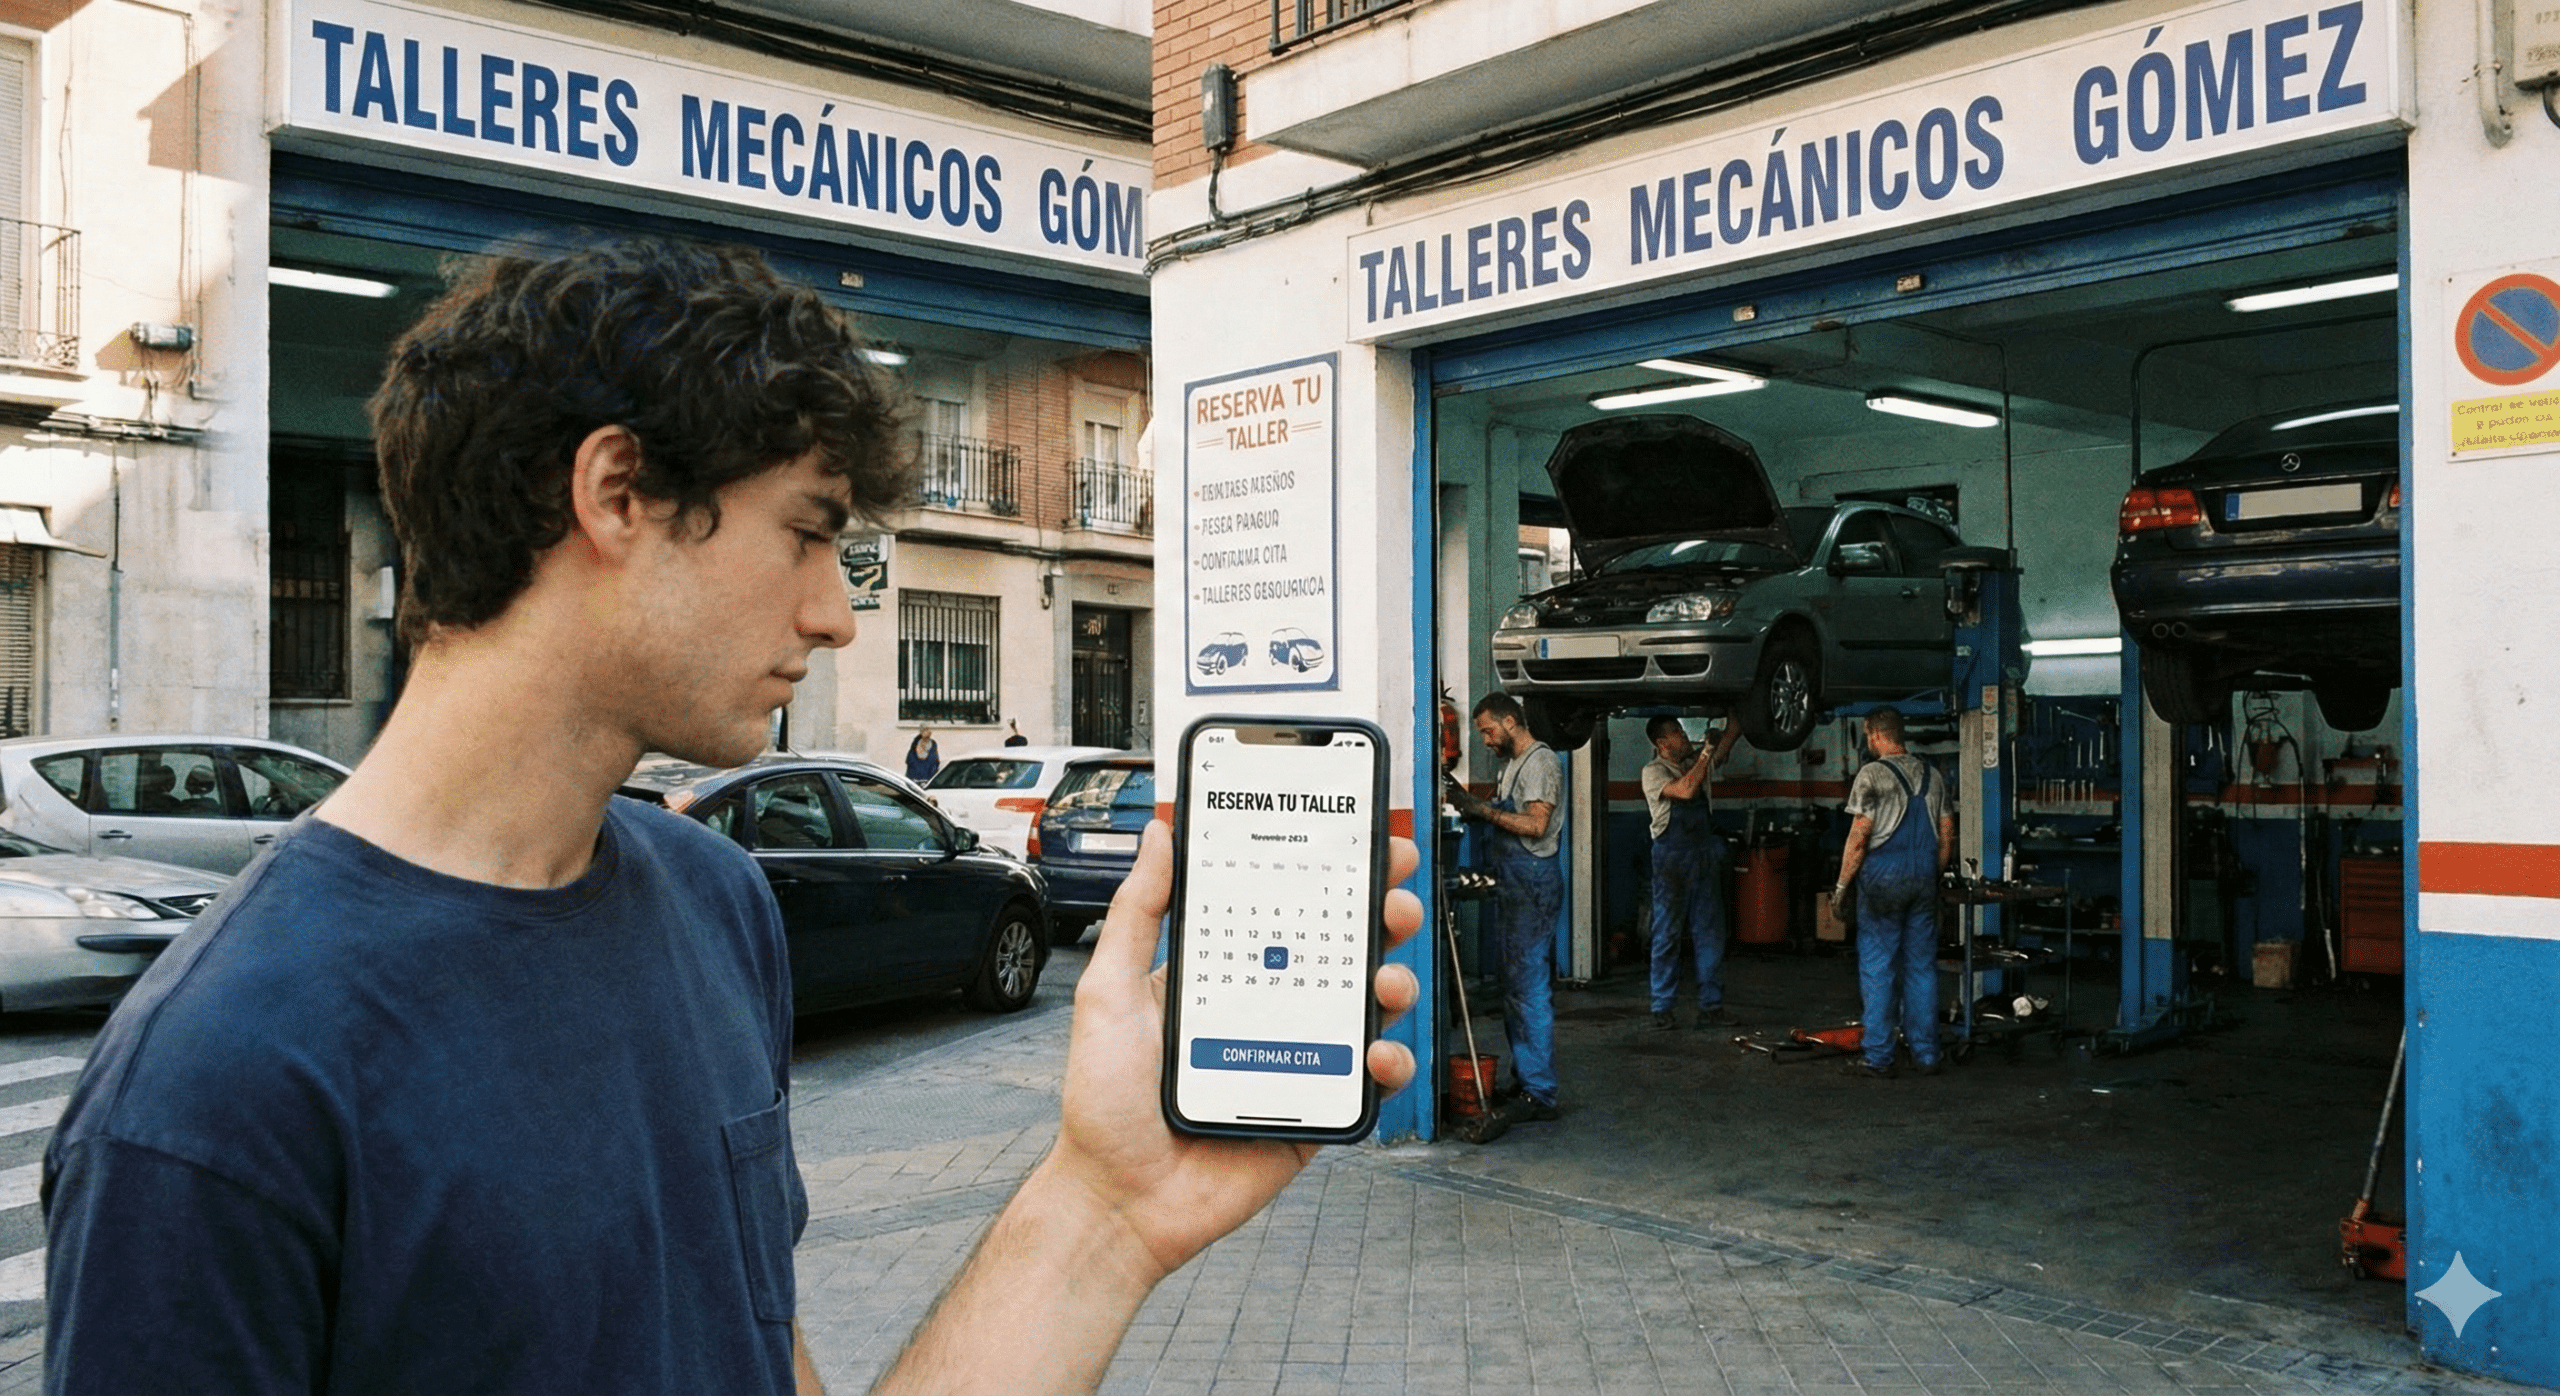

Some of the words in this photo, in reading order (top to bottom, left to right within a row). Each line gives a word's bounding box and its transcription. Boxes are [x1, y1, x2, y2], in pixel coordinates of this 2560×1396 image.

[312, 19, 639, 168] TALLERES
[681, 93, 1002, 233] MECÁNICOS
[1359, 199, 1592, 323] TALLERES
[1630, 95, 2004, 266] MECÁNICOS
[2073, 0, 2367, 166] GÓMEZ
[1197, 383, 1286, 424] RESERVA
[1292, 374, 1322, 404] TU
[1226, 418, 1289, 451] TALLER
[1207, 791, 1274, 811] RESERVA
[1278, 794, 1297, 812] TU
[1300, 794, 1356, 814] TALLER
[1323, 886, 1329, 896] 1
[1346, 887, 1354, 897] 2
[1202, 904, 1209, 915] 3
[1226, 905, 1233, 915] 4
[1250, 906, 1258, 916] 5
[1273, 907, 1281, 917] 6
[1321, 909, 1329, 919] 8
[1199, 927, 1211, 938] 10
[1224, 928, 1234, 938] 11
[1248, 929, 1259, 939] 12
[1271, 930, 1282, 941] 13
[1295, 931, 1306, 940] 14
[1319, 932, 1331, 942] 15
[1343, 933, 1355, 943] 16
[1198, 950, 1210, 960] 17
[1222, 951, 1234, 961] 18
[1247, 952, 1259, 962] 19
[1293, 954, 1305, 964] 21
[1317, 955, 1330, 965] 22
[1341, 956, 1354, 966] 23
[1220, 974, 1233, 984] 25
[1244, 975, 1258, 985] 26
[1268, 976, 1281, 986] 27
[1292, 977, 1306, 987] 28
[1316, 978, 1330, 989] 29
[1340, 979, 1354, 990] 30
[1222, 1047, 1291, 1065] CONFIRMAR
[1294, 1051, 1321, 1066] CITA
